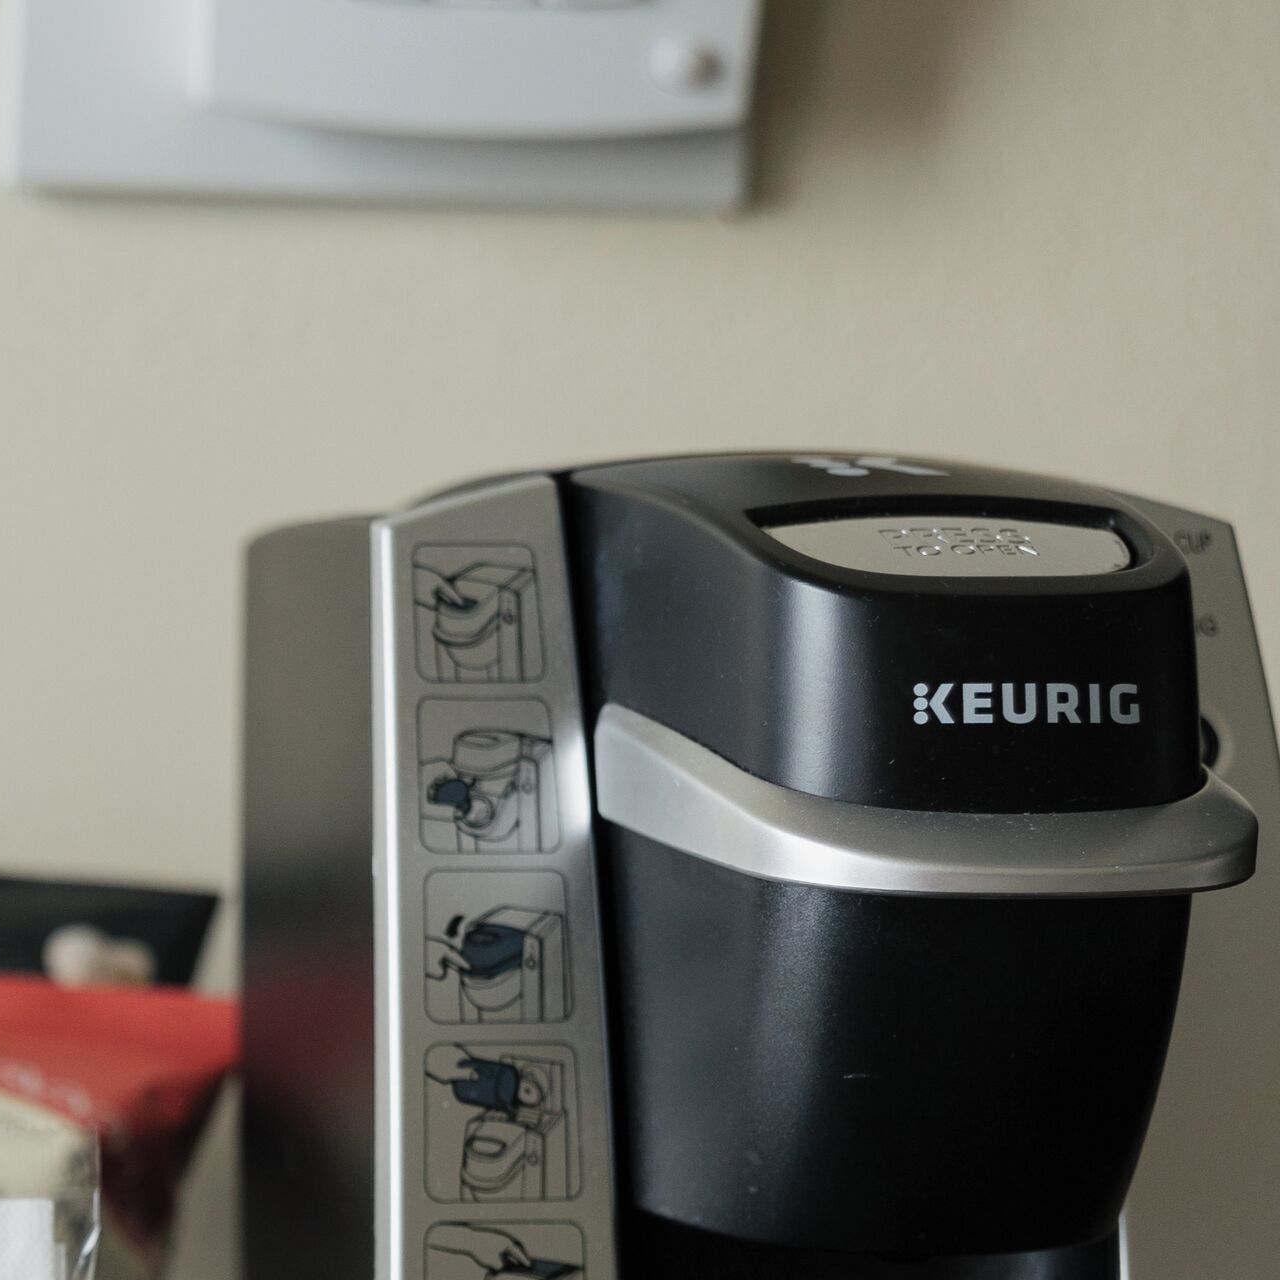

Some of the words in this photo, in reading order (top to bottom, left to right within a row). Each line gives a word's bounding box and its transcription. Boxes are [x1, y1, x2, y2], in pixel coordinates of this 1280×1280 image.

[878, 526, 1031, 545] PRESS
[893, 544, 941, 557] TO
[950, 544, 1041, 557] OPEN
[913, 683, 1141, 726] KEURIG
